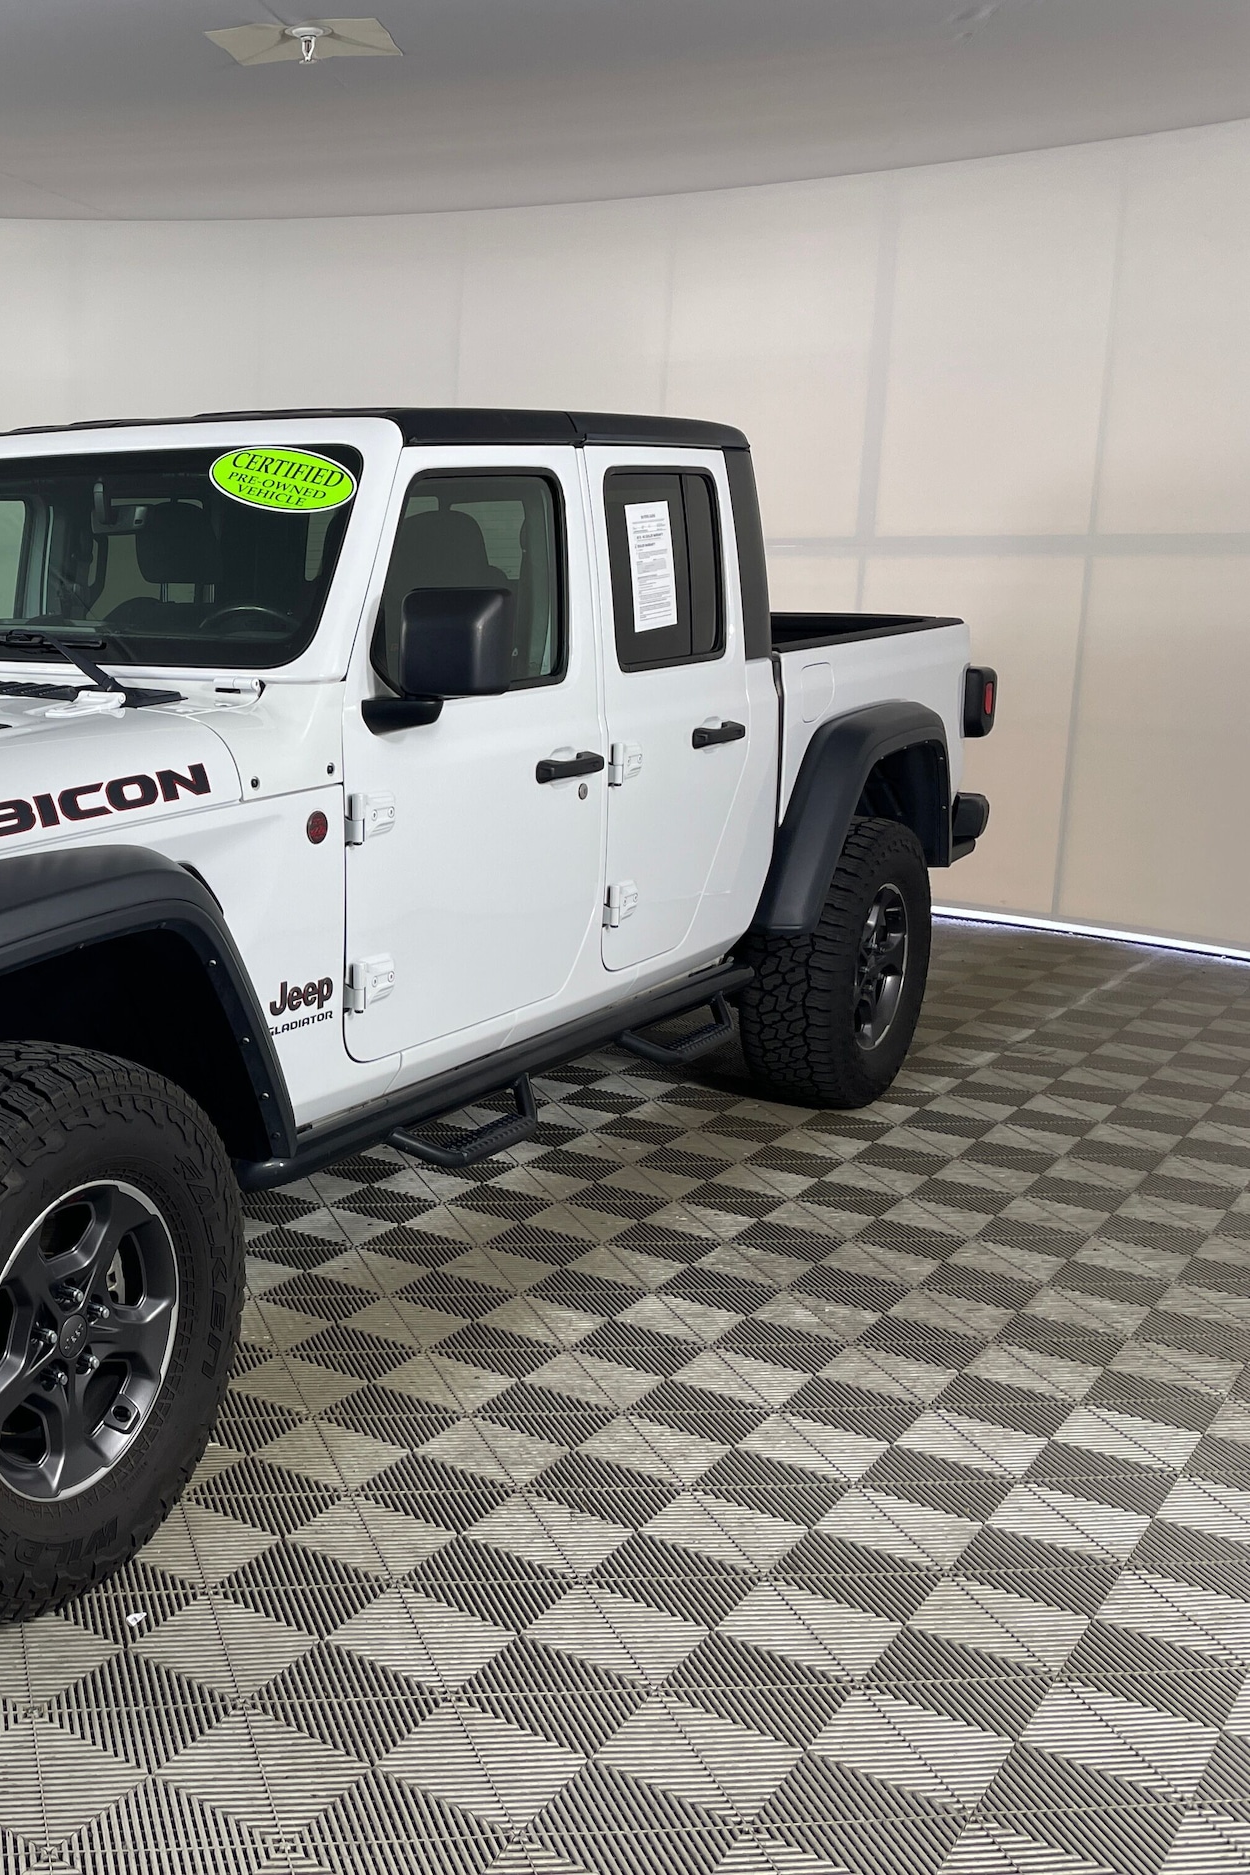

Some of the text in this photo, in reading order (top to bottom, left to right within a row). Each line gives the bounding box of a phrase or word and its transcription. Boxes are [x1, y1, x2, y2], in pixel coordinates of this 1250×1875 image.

[227, 471, 327, 499] PRE-OWNED
[232, 452, 345, 488] CERTIFIED
[237, 484, 307, 507] VEHICLE
[269, 976, 334, 1017] Jeep
